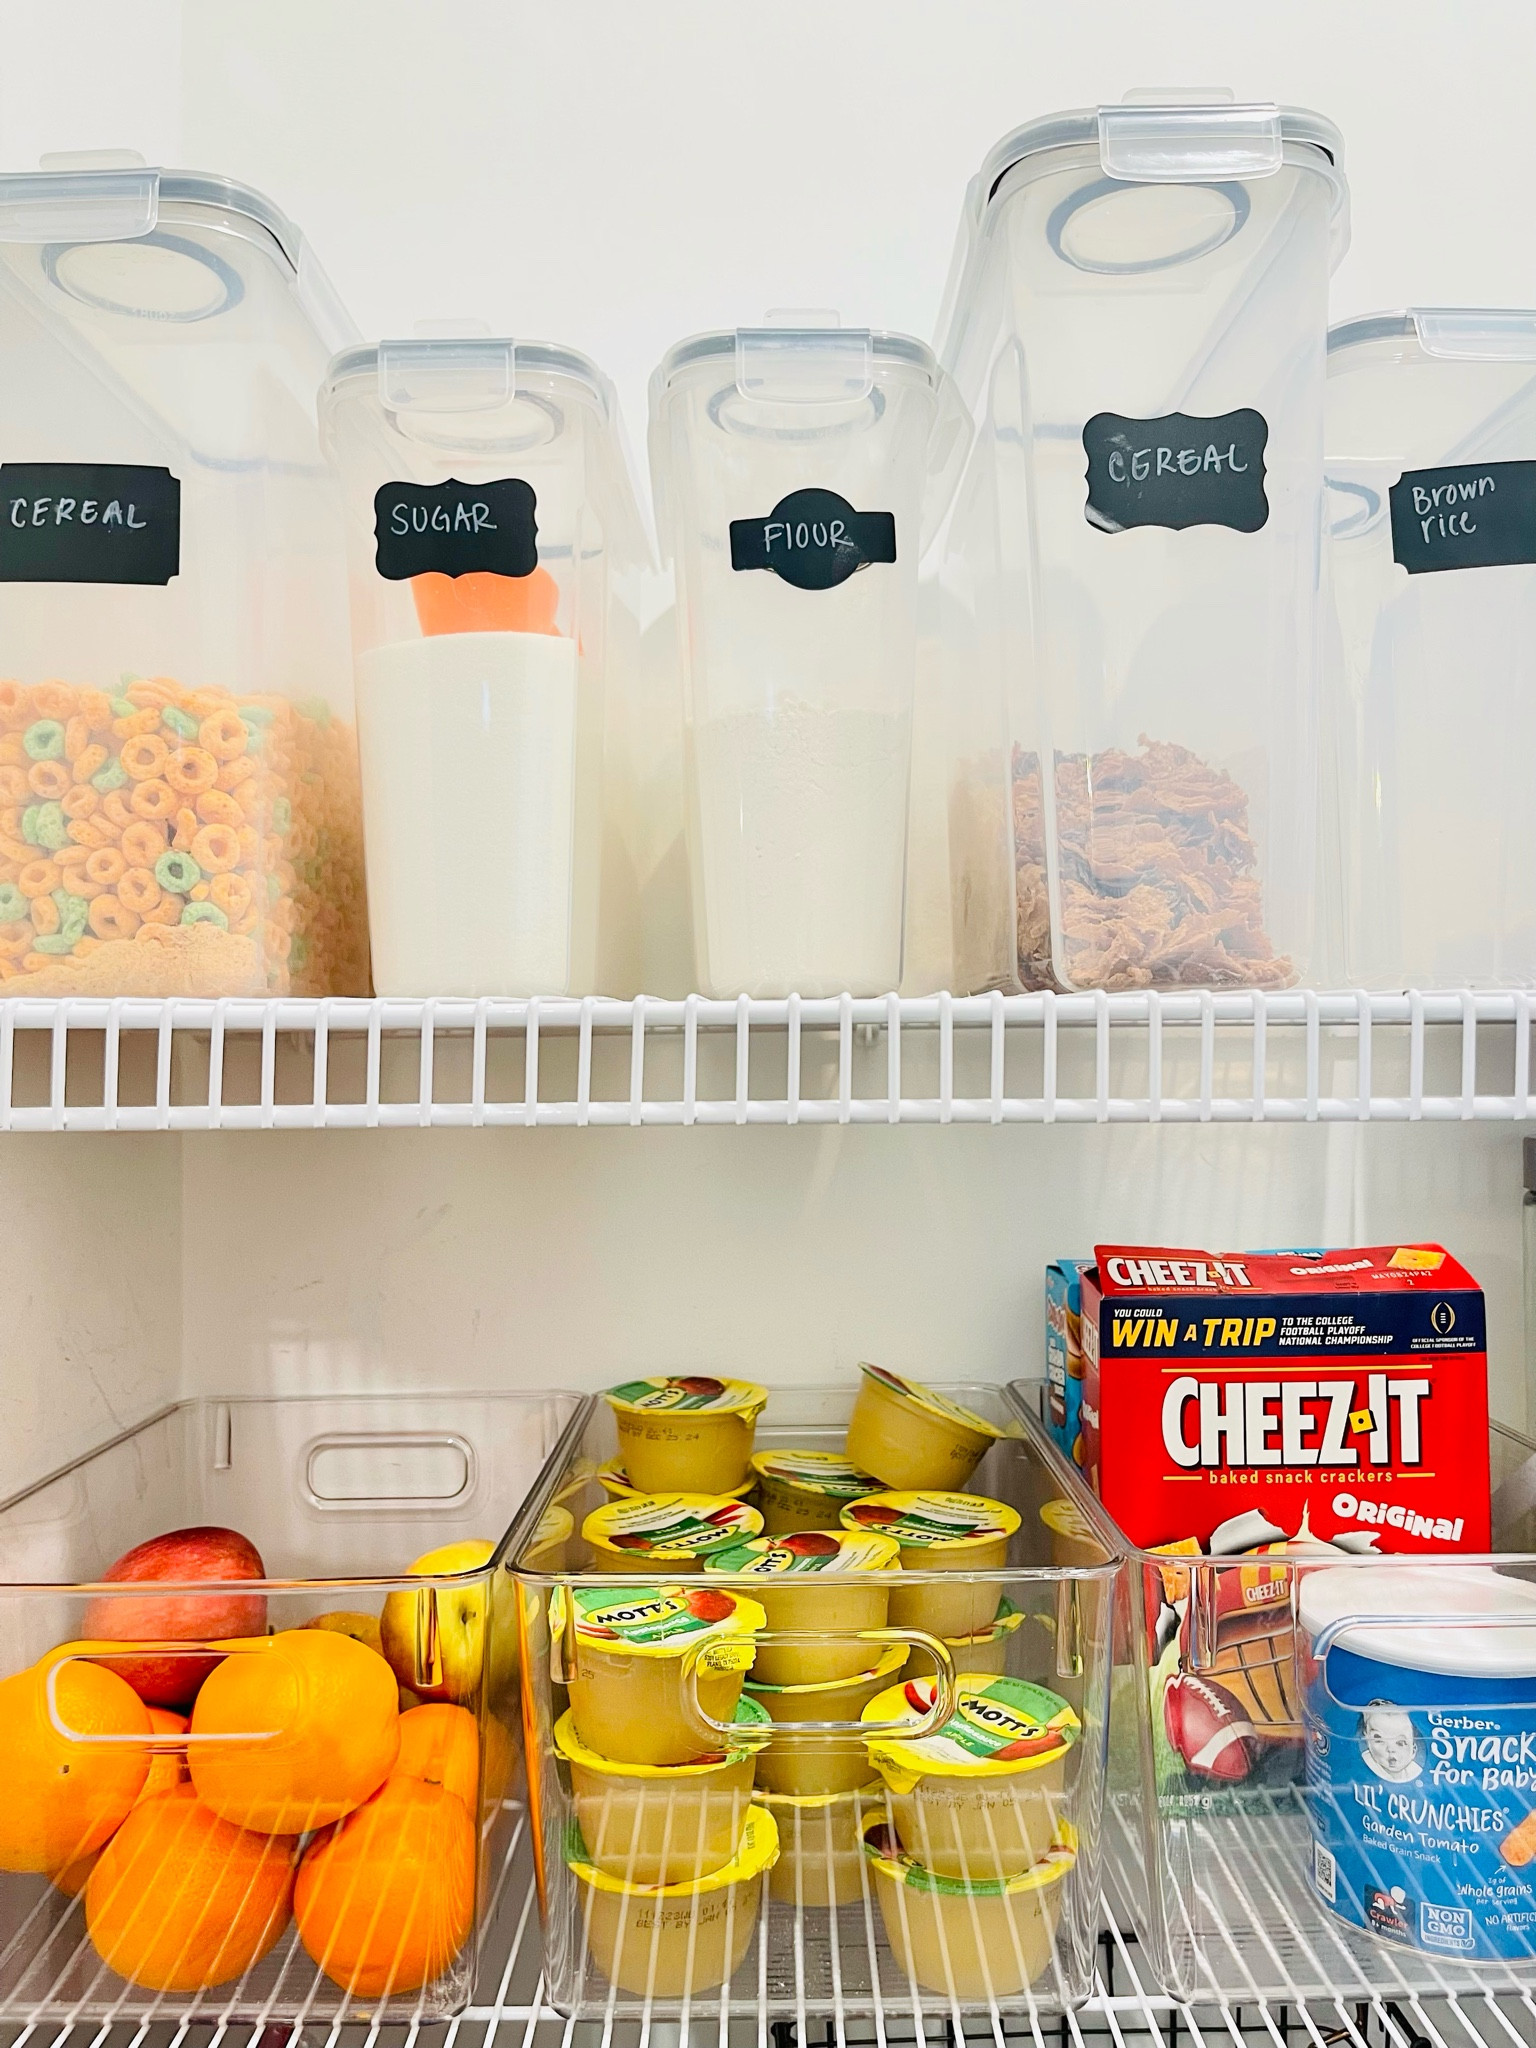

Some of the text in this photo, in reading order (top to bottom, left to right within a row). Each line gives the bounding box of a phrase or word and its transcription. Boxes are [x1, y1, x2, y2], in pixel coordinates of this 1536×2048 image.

[1108, 444, 1248, 482] CEREAL
[1412, 476, 1495, 515] Brown
[10, 498, 147, 528] CEREAL
[391, 502, 498, 535] SUGAR
[1421, 511, 1477, 544] rice
[1114, 1308, 1163, 1318] YOU COULD
[1281, 1316, 1354, 1326] TO THE COLLEGE
[1112, 1318, 1179, 1347] WIN
[1183, 1323, 1197, 1342] A
[1202, 1317, 1277, 1347] TRIP
[1278, 1335, 1394, 1346] NATIONAL CHAMPIONSHIP
[1280, 1325, 1366, 1336] FOOTBALL PLAYOFF
[1208, 1468, 1393, 1484] baked snack crackers
[596, 1599, 679, 1624] MOTT'S
[961, 1699, 1040, 1738] MOTT'S
[1428, 1712, 1495, 1731] Gerber
[1429, 1760, 1475, 1786] for
[1353, 1782, 1504, 1833] LIL' CRUNCHIES
[1362, 1814, 1479, 1854] Garden Tomato
[1363, 1833, 1441, 1864] Baked Grain Snack
[1456, 1883, 1533, 1898] Whole grains
[1369, 1909, 1409, 1930] Crawler
[1428, 1907, 1465, 1924] NON
[1485, 1914, 1500, 1926] NO
[1427, 1921, 1466, 1937] GMO
